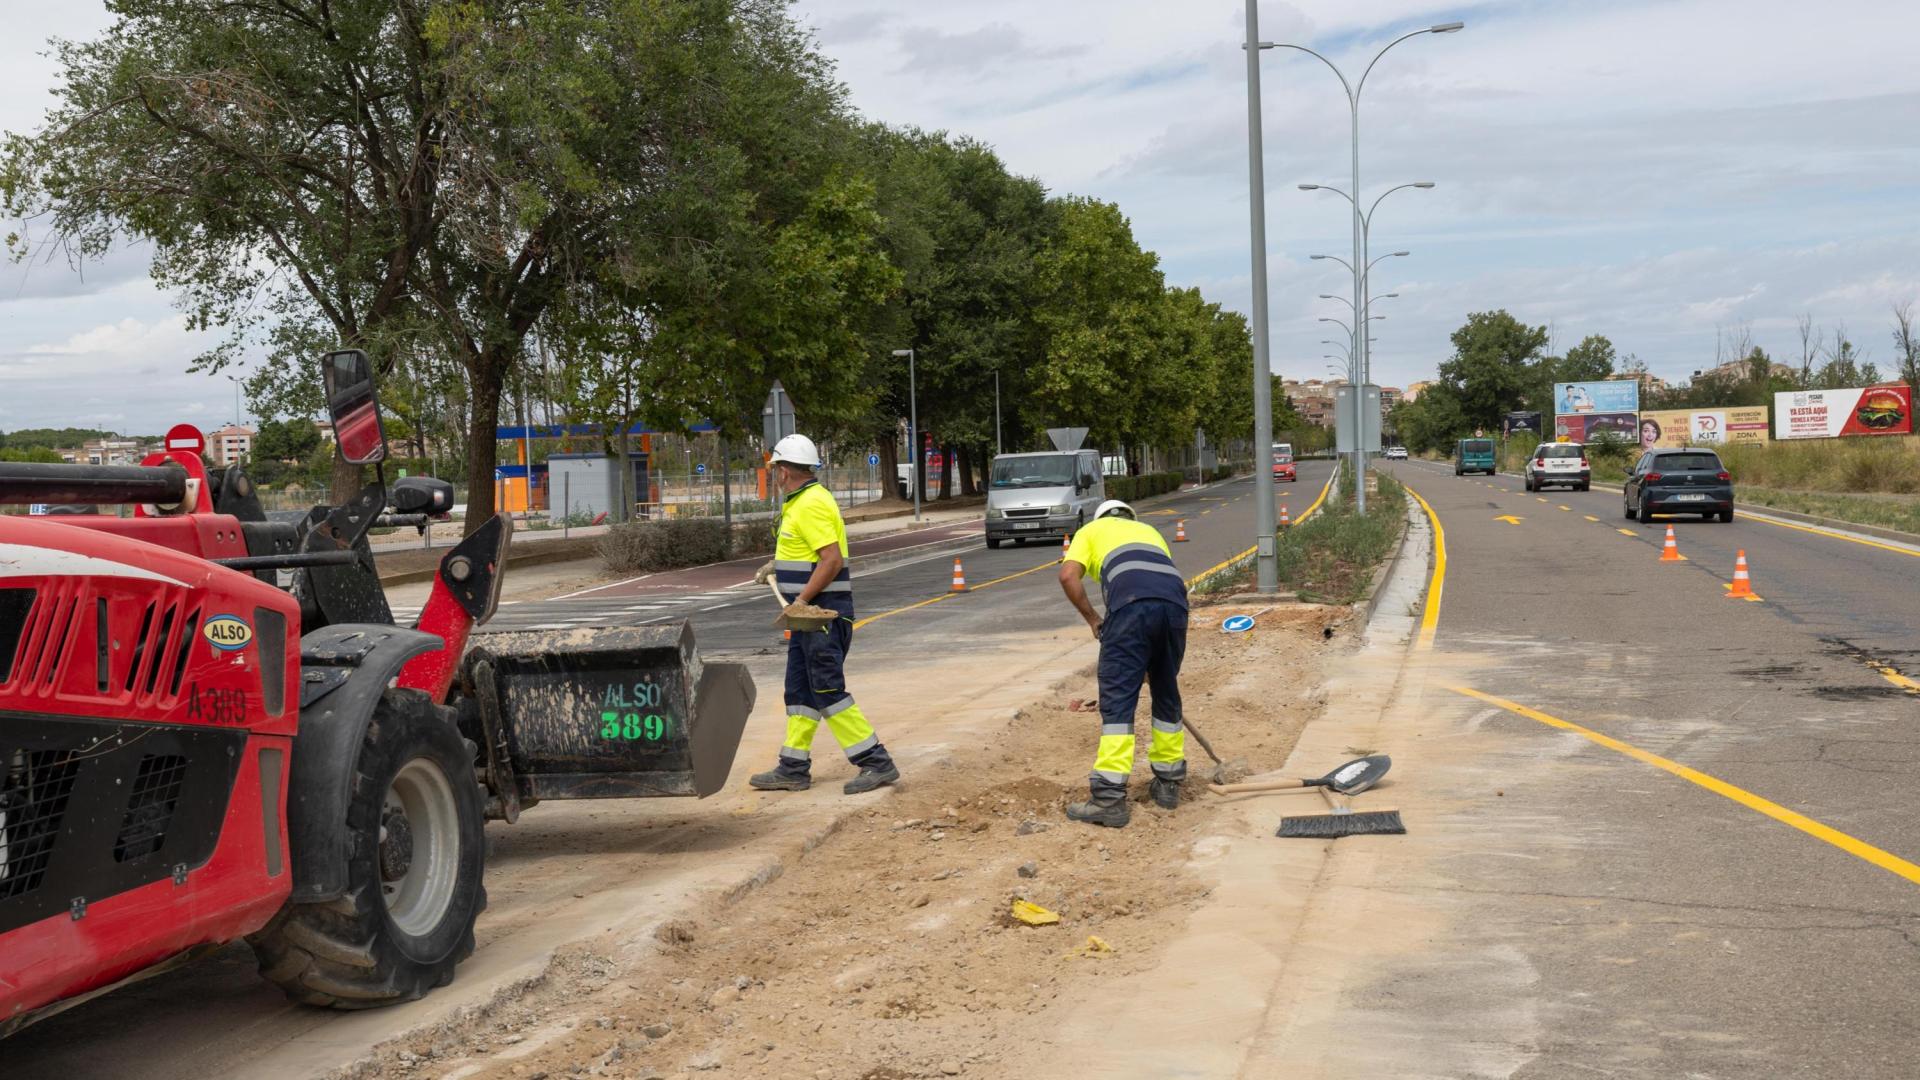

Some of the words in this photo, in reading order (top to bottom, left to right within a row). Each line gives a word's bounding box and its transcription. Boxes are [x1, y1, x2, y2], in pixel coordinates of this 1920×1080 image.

[1698, 431, 1718, 440] KIT
[211, 624, 245, 640] ALSO
[604, 683, 661, 707] ALSO
[601, 712, 664, 740] 389
